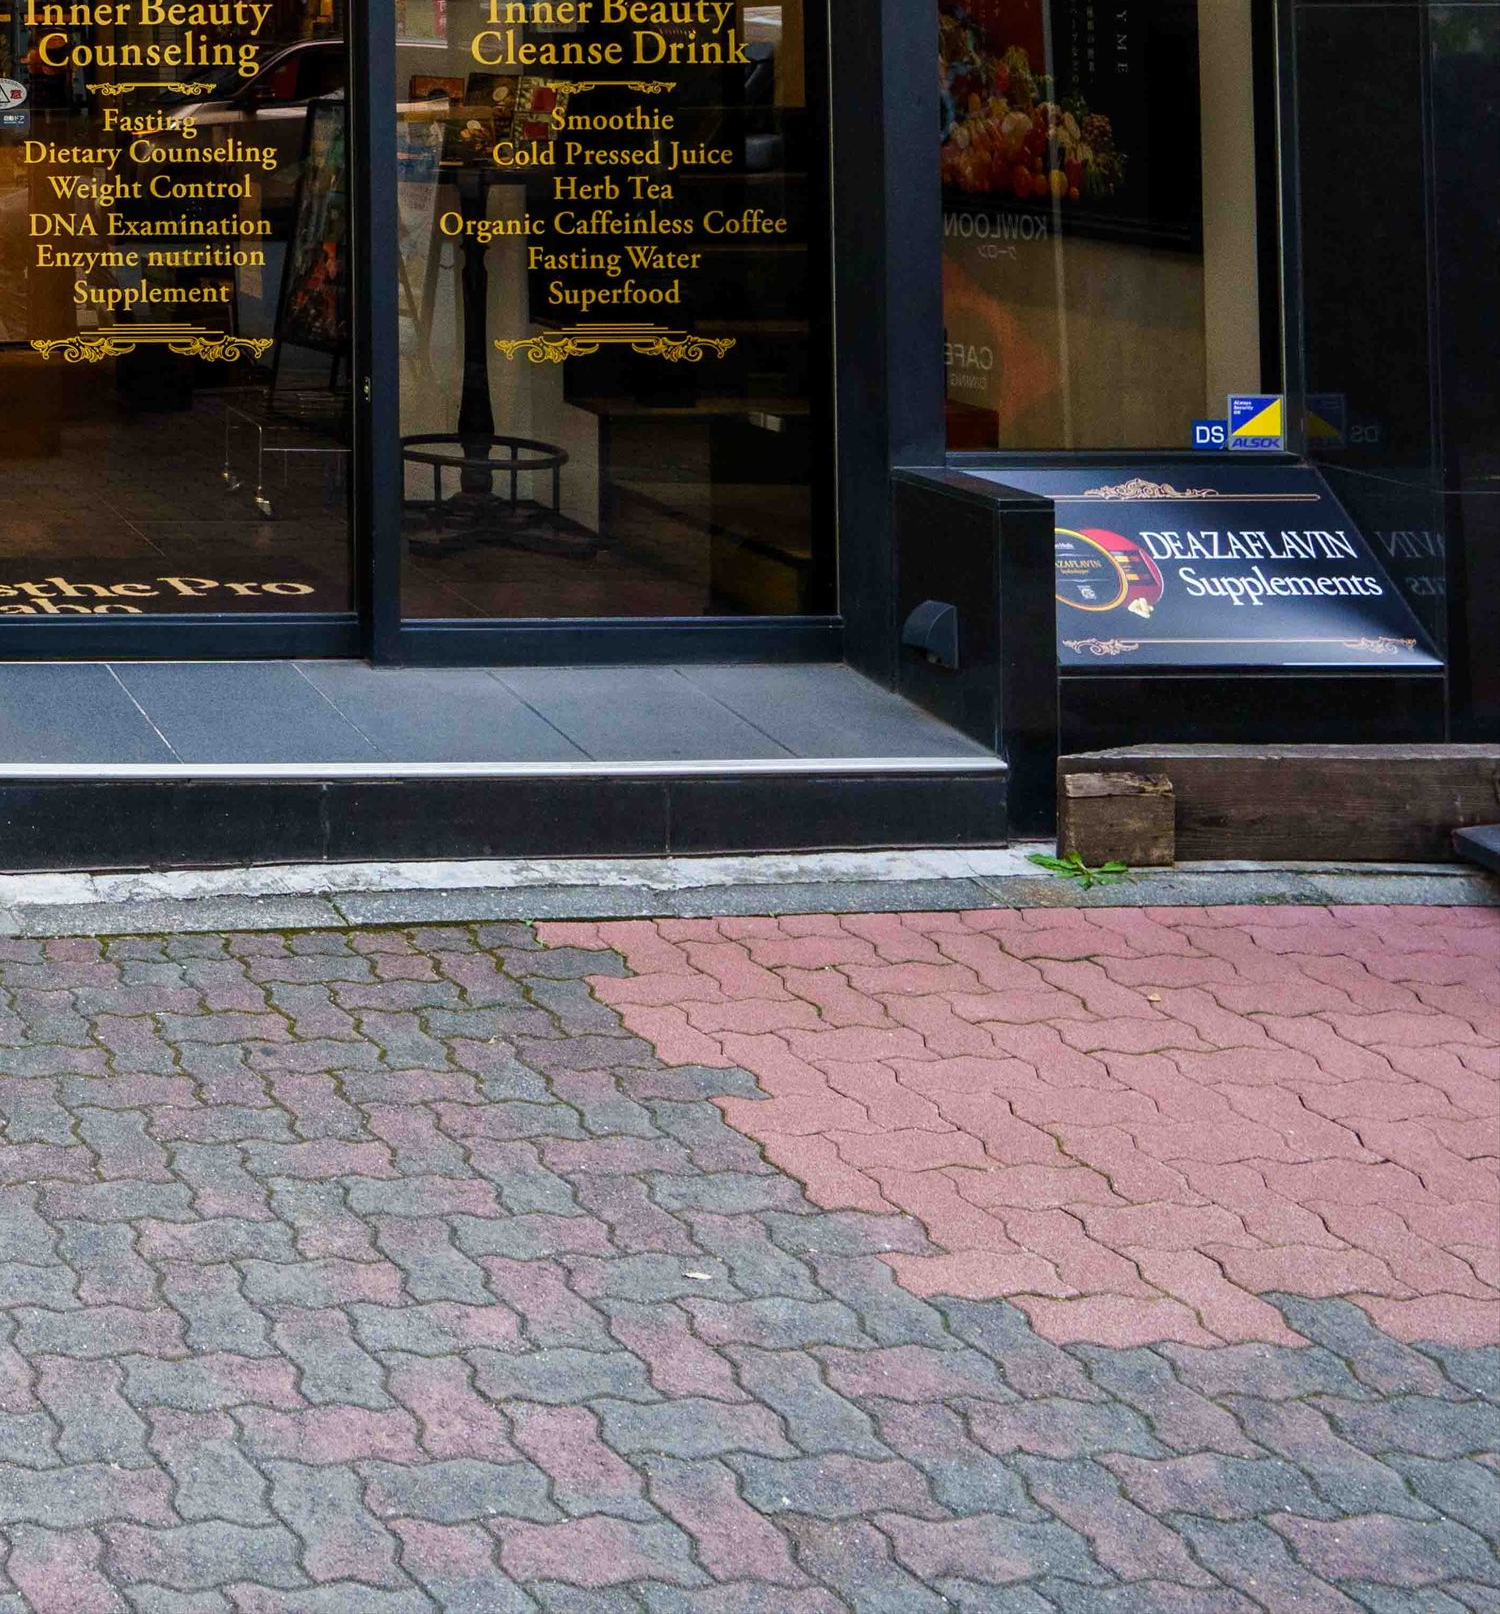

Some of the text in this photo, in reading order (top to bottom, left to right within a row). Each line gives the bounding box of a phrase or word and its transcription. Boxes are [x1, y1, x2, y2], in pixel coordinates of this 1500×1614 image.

[38, 31, 260, 78] Counseling
[471, 29, 751, 65] Cleanse Drink
[102, 108, 197, 139] Fasting
[551, 106, 675, 131] Smoothie
[24, 138, 278, 171] Dietary Counseling
[492, 141, 734, 171] Cold Pressed Juice
[48, 174, 252, 205] Weight Control
[553, 176, 674, 200] Herb Tea
[29, 212, 272, 237] DNA Examination
[439, 209, 788, 243] Organic Caffeinless Coffee
[36, 244, 266, 274] Enzyme nutrition
[528, 246, 701, 277] Fasting Water
[73, 280, 230, 311] Supplement
[548, 279, 681, 312] Superfood
[1195, 426, 1226, 444] DS
[1231, 437, 1281, 449] ALSOK
[1138, 530, 1359, 560] DEAZAFLAVIN
[156, 577, 315, 596] Pro
[1178, 565, 1383, 606] Supplements
